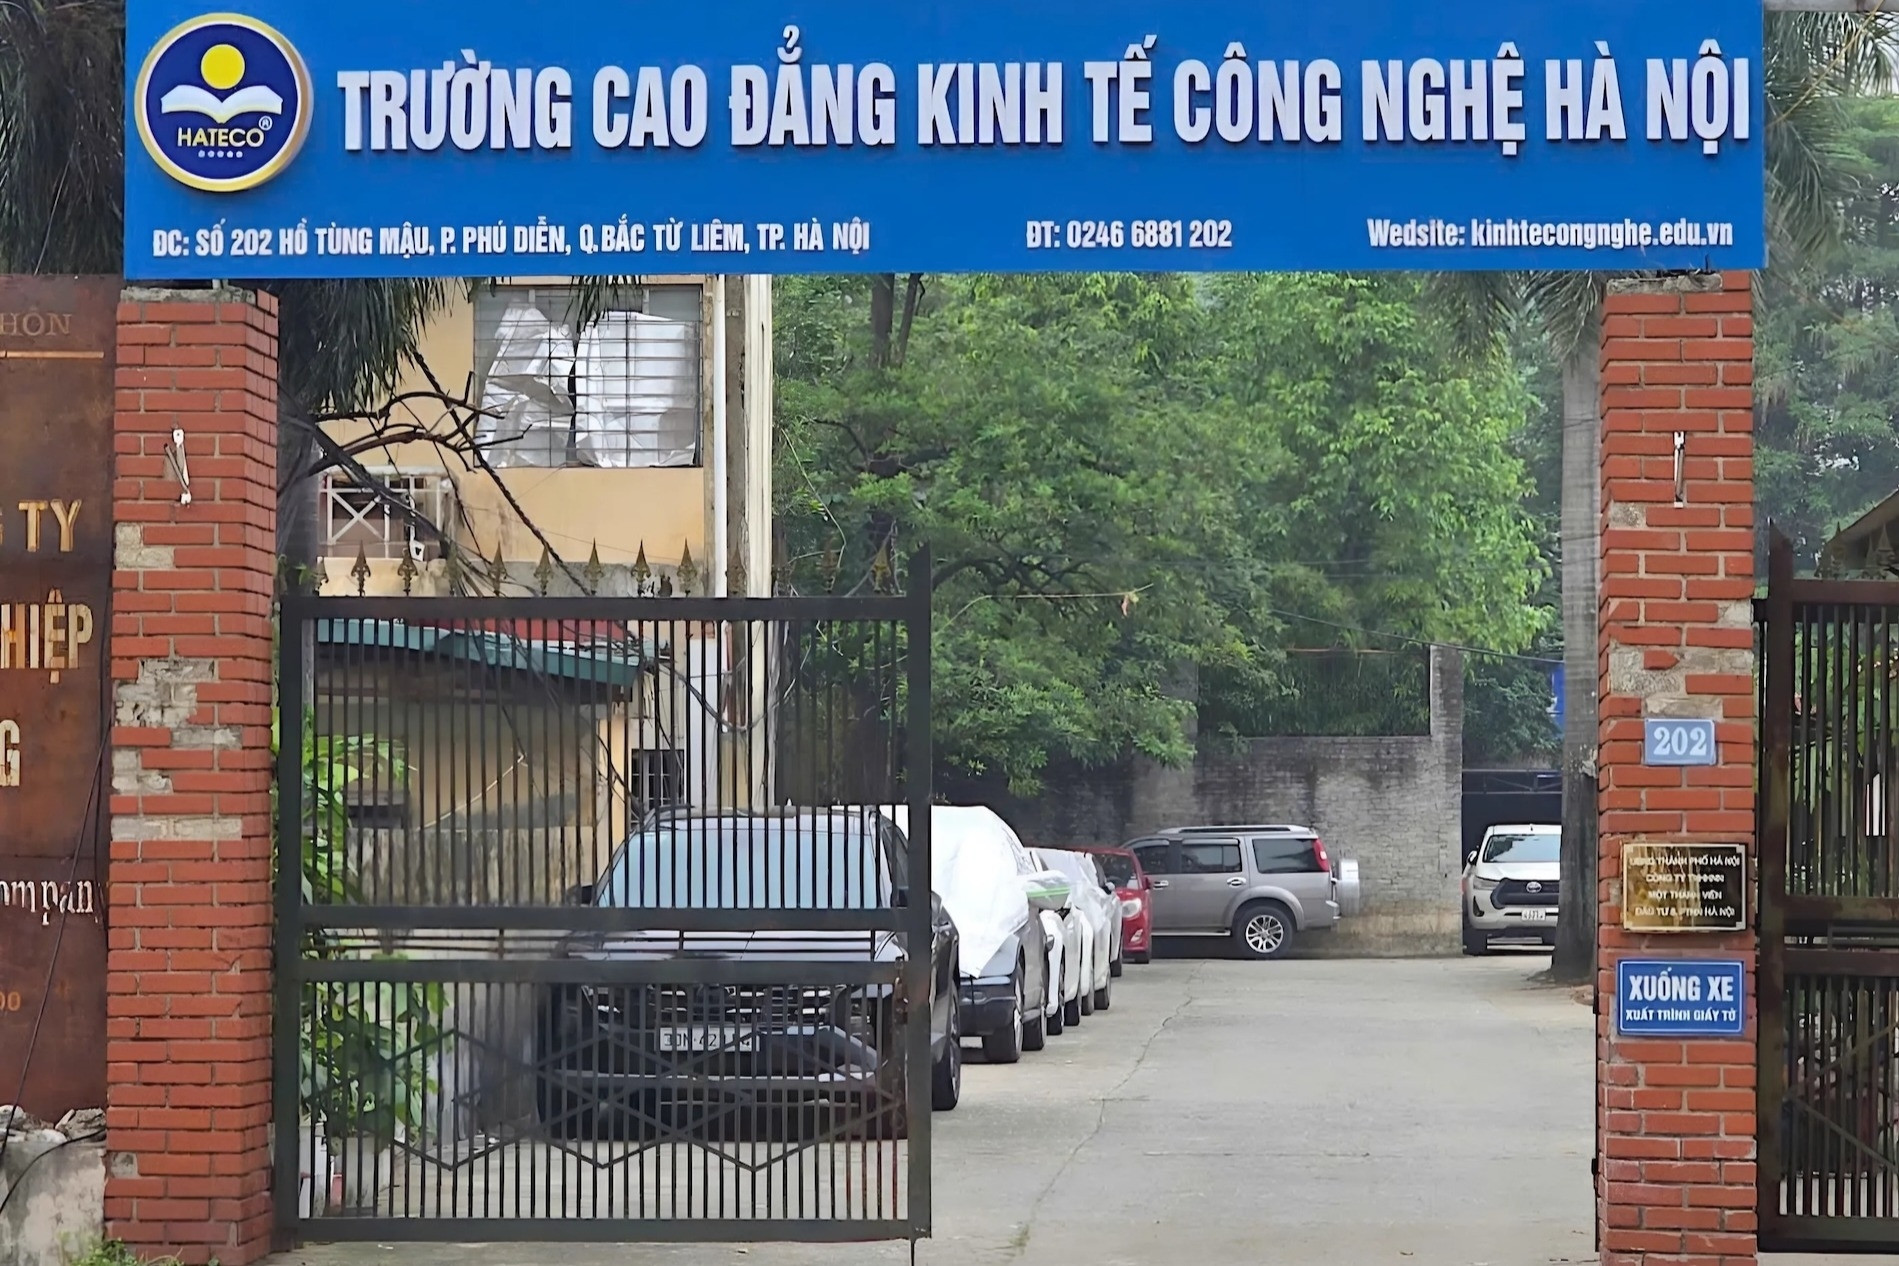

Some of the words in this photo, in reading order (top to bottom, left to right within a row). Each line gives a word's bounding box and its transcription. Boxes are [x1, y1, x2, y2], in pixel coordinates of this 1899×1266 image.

[338, 49, 572, 150] TRƯỜNG
[593, 65, 707, 148] CAO
[729, 25, 896, 146] ĐẲNG
[918, 62, 1063, 144] KINH
[1084, 34, 1157, 142] TẾ
[1173, 42, 1342, 143] CÔNG
[1361, 41, 1526, 155] NGHỆ
[1545, 41, 1627, 140] HÀ
[1646, 39, 1749, 154] NỘI
[177, 127, 264, 148] HATECO
[152, 229, 189, 257] ĐC:
[195, 218, 226, 256] SỐ
[230, 228, 273, 256] 202
[279, 218, 308, 255] HỒ
[314, 222, 373, 255] TÙNG
[379, 221, 435, 259] MẬU,
[440, 226, 456, 254] P.
[462, 220, 507, 254] PHÚ
[513, 216, 571, 255] DIỄN,
[652, 217, 684, 251] TỪ
[691, 218, 750, 254] LIÊM,
[756, 223, 786, 251] TP.
[793, 217, 824, 251] HÀ
[832, 216, 870, 255] NỘI
[1026, 220, 1060, 248] ĐT:
[1066, 220, 1124, 248] 0246
[1131, 220, 1182, 248] 6881
[1189, 219, 1232, 248] 202
[1471, 217, 1733, 250] kinhtecongnghe.edu.vn
[18, 499, 82, 552] TY
[1653, 726, 1707, 756] 202
[1629, 967, 1700, 1001] XUỐNG
[1707, 976, 1733, 1001] XE
